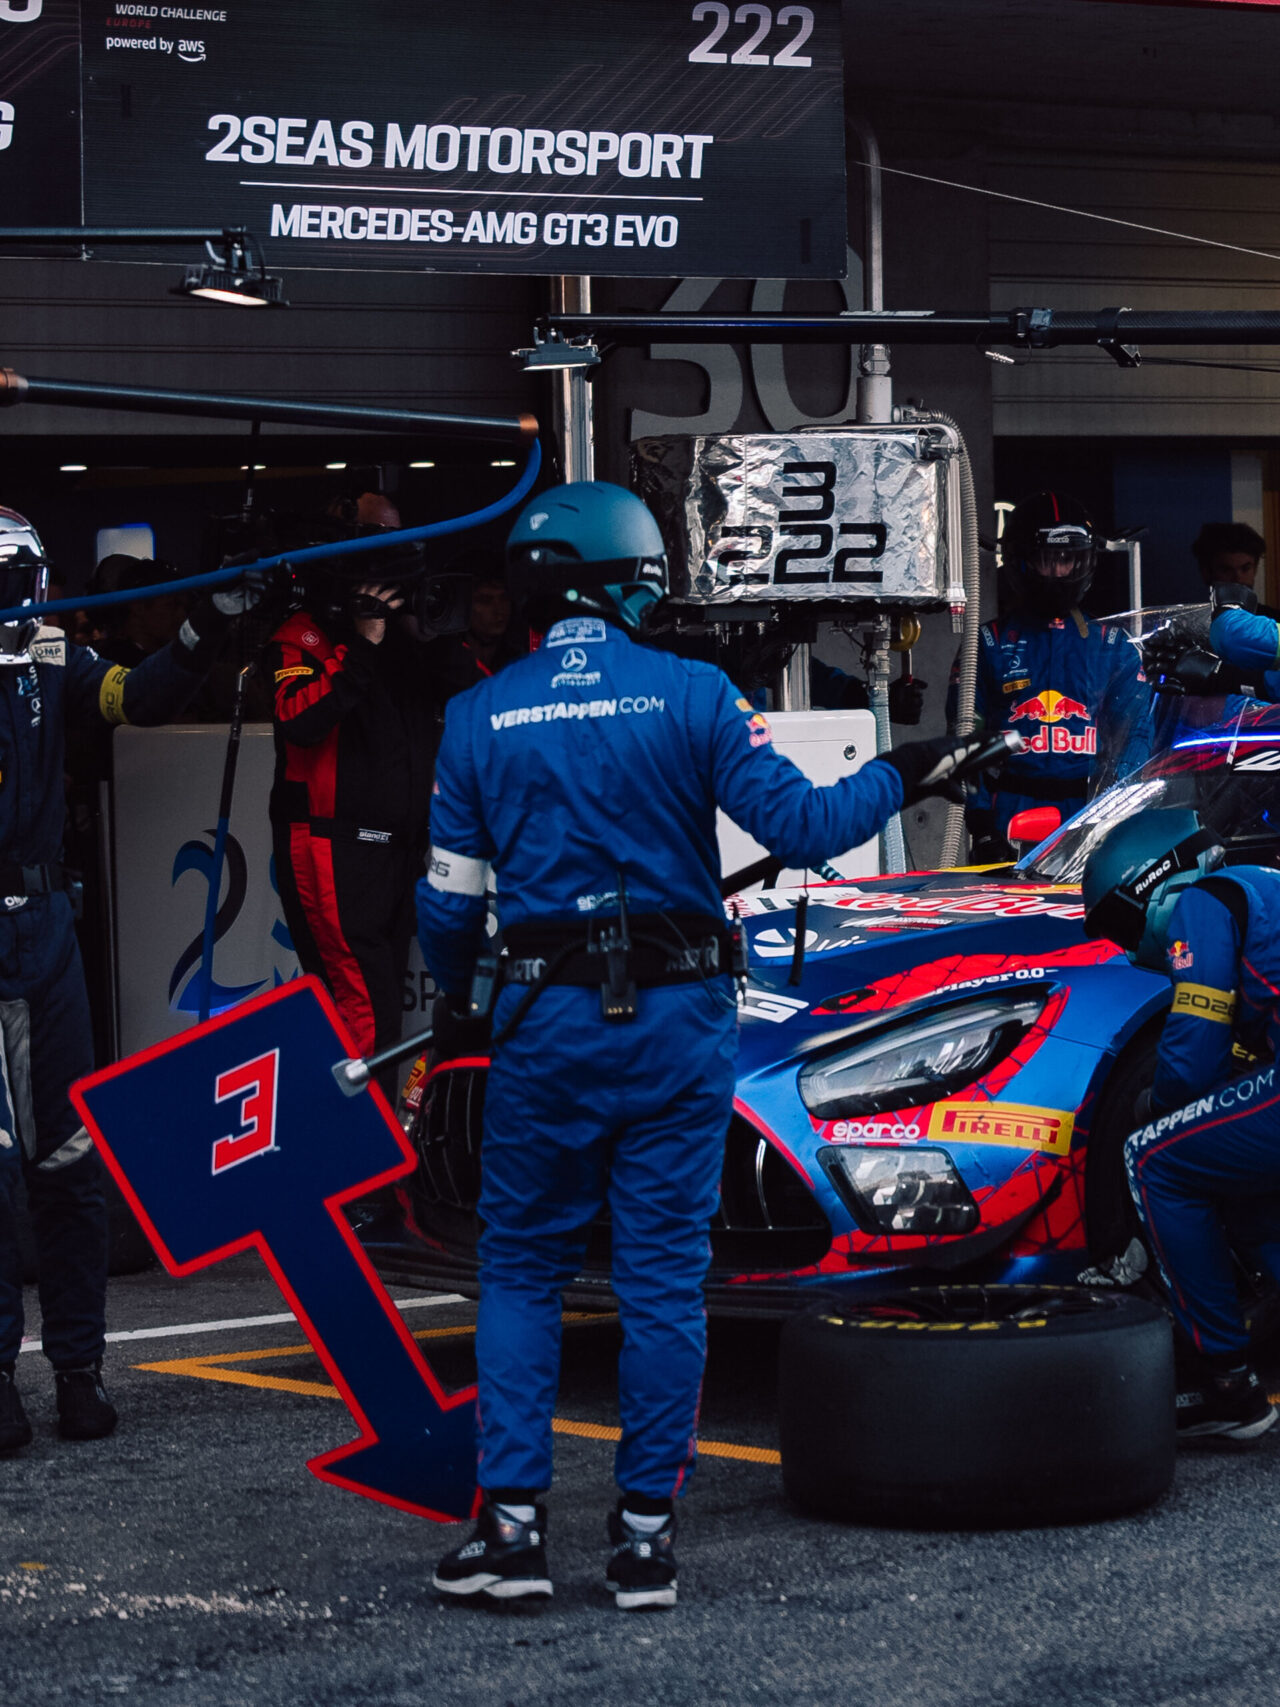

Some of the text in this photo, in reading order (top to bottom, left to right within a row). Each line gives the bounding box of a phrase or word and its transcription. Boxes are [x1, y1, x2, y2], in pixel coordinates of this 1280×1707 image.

[106, 17, 152, 29] EUROPE
[115, 3, 228, 22] WORLD CHALLENGE
[106, 37, 206, 56] powered by aws
[688, 3, 815, 67] 222
[205, 114, 713, 180] 2SEAS MOTORSPORT
[270, 204, 679, 248] MERCEDES-AMG GT3 EVO
[778, 460, 837, 523] 3
[715, 521, 888, 586] 222
[35, 645, 61, 659] OMP
[489, 695, 666, 732] VERSTAPPEN.COM
[1018, 726, 1097, 756] ed Bull
[934, 967, 1045, 996] Player 0.0
[211, 1047, 280, 1176] 3
[941, 1109, 1062, 1145] PIRELLI
[1124, 1068, 1275, 1151] TAPPEN.COM
[831, 1121, 921, 1144] sparco
